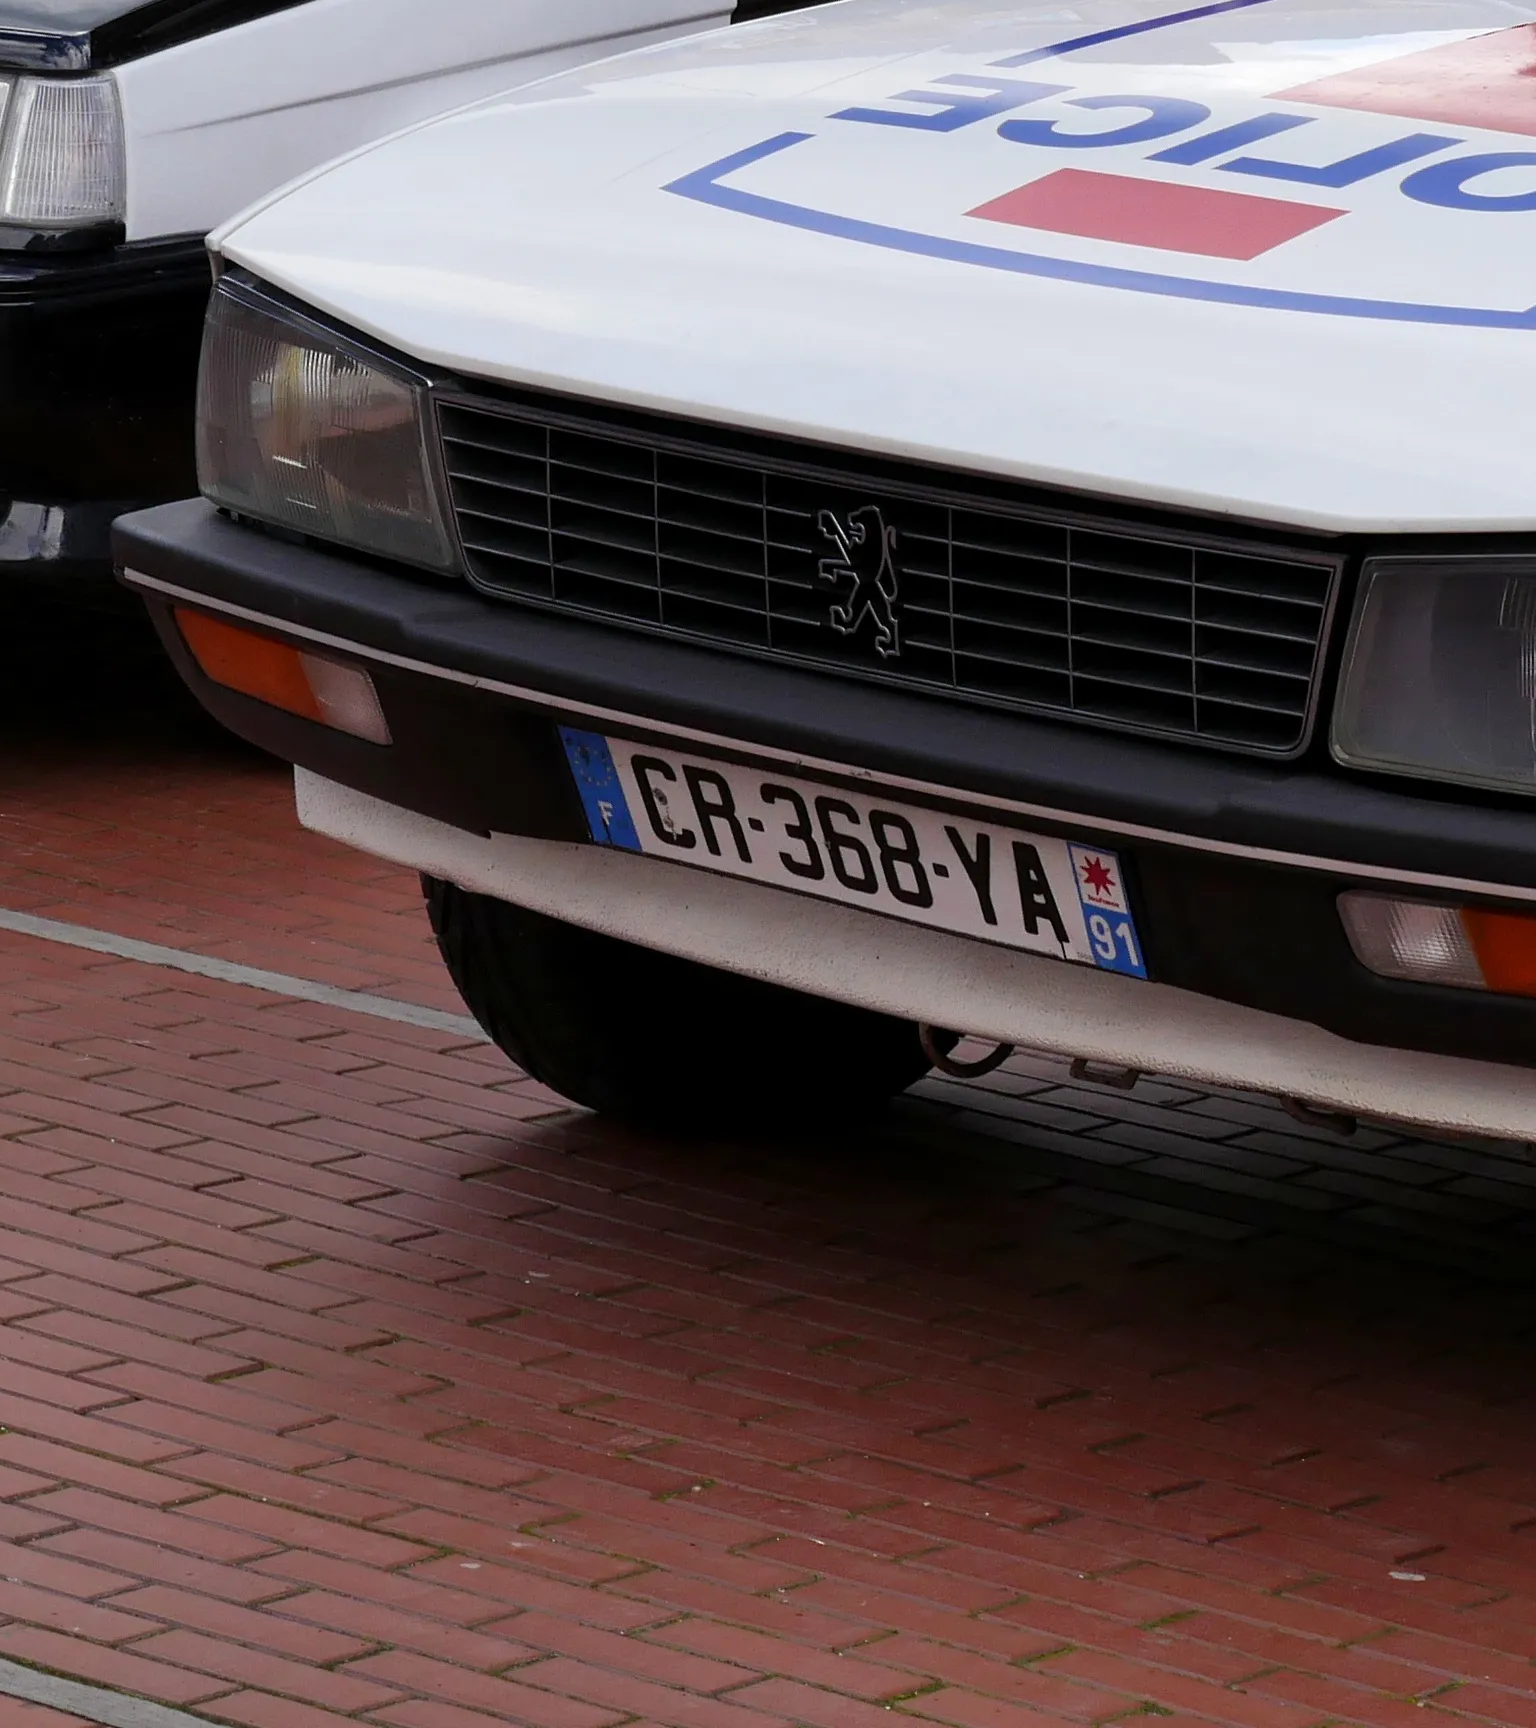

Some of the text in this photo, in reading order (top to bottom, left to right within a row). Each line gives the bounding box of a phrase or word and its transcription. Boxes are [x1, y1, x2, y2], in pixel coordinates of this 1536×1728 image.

[597, 753, 1070, 944] F CR-368-YA
[1089, 914, 1139, 967] 91
